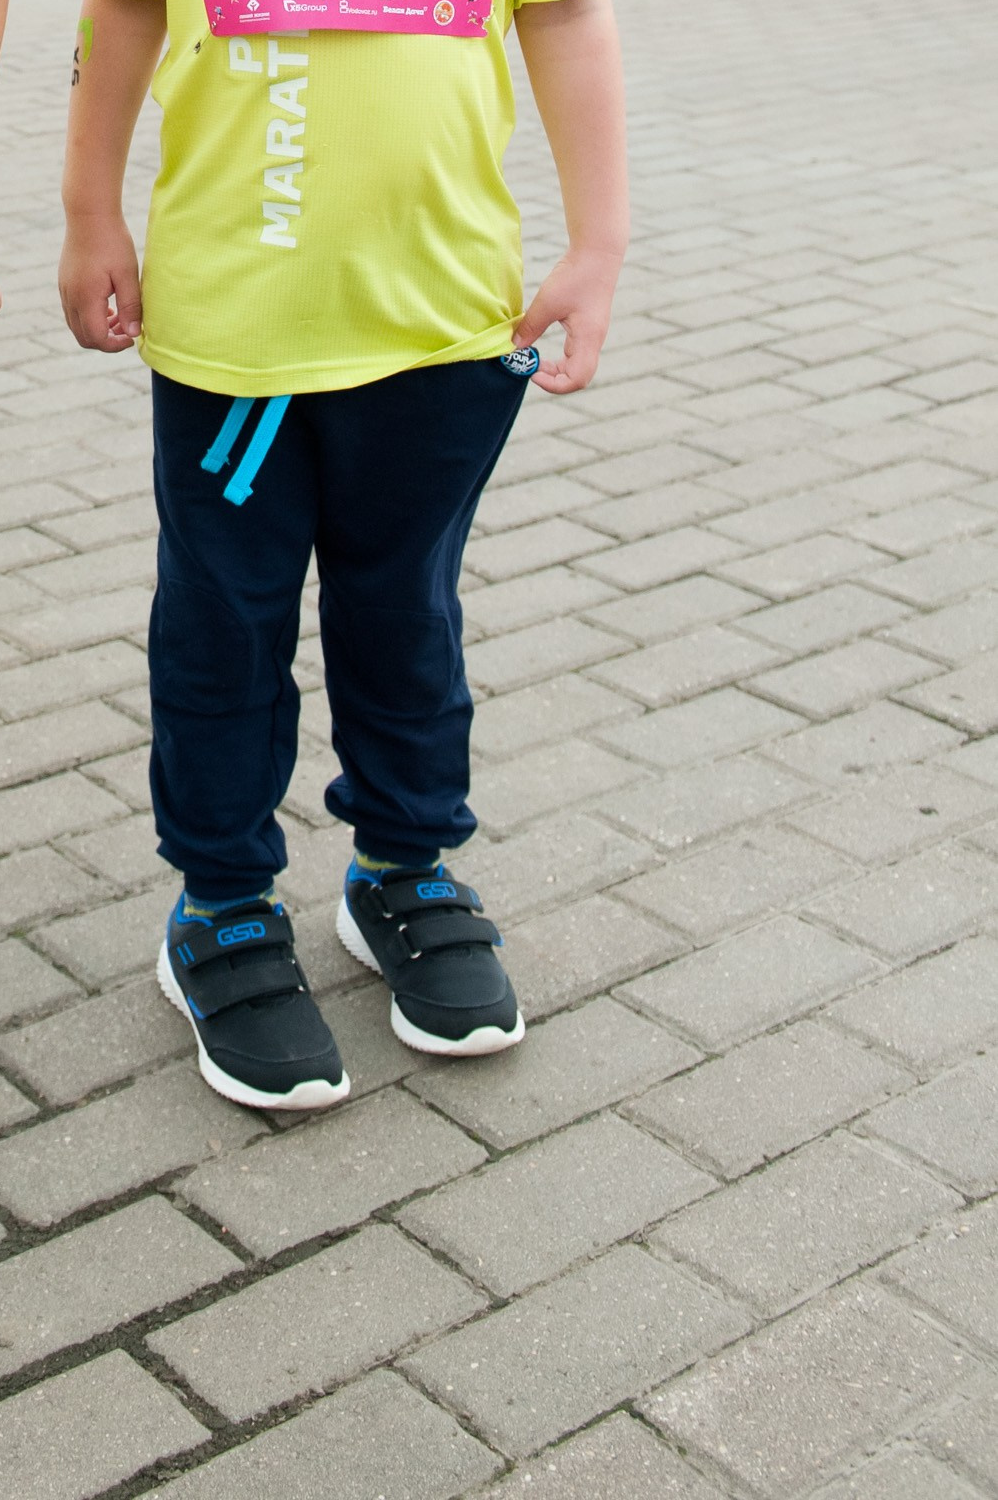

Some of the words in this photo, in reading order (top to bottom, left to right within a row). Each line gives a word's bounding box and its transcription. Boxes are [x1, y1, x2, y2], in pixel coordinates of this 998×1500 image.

[260, 30, 309, 248] MARAT
[416, 881, 457, 899] GSD
[217, 921, 266, 947] GSD
